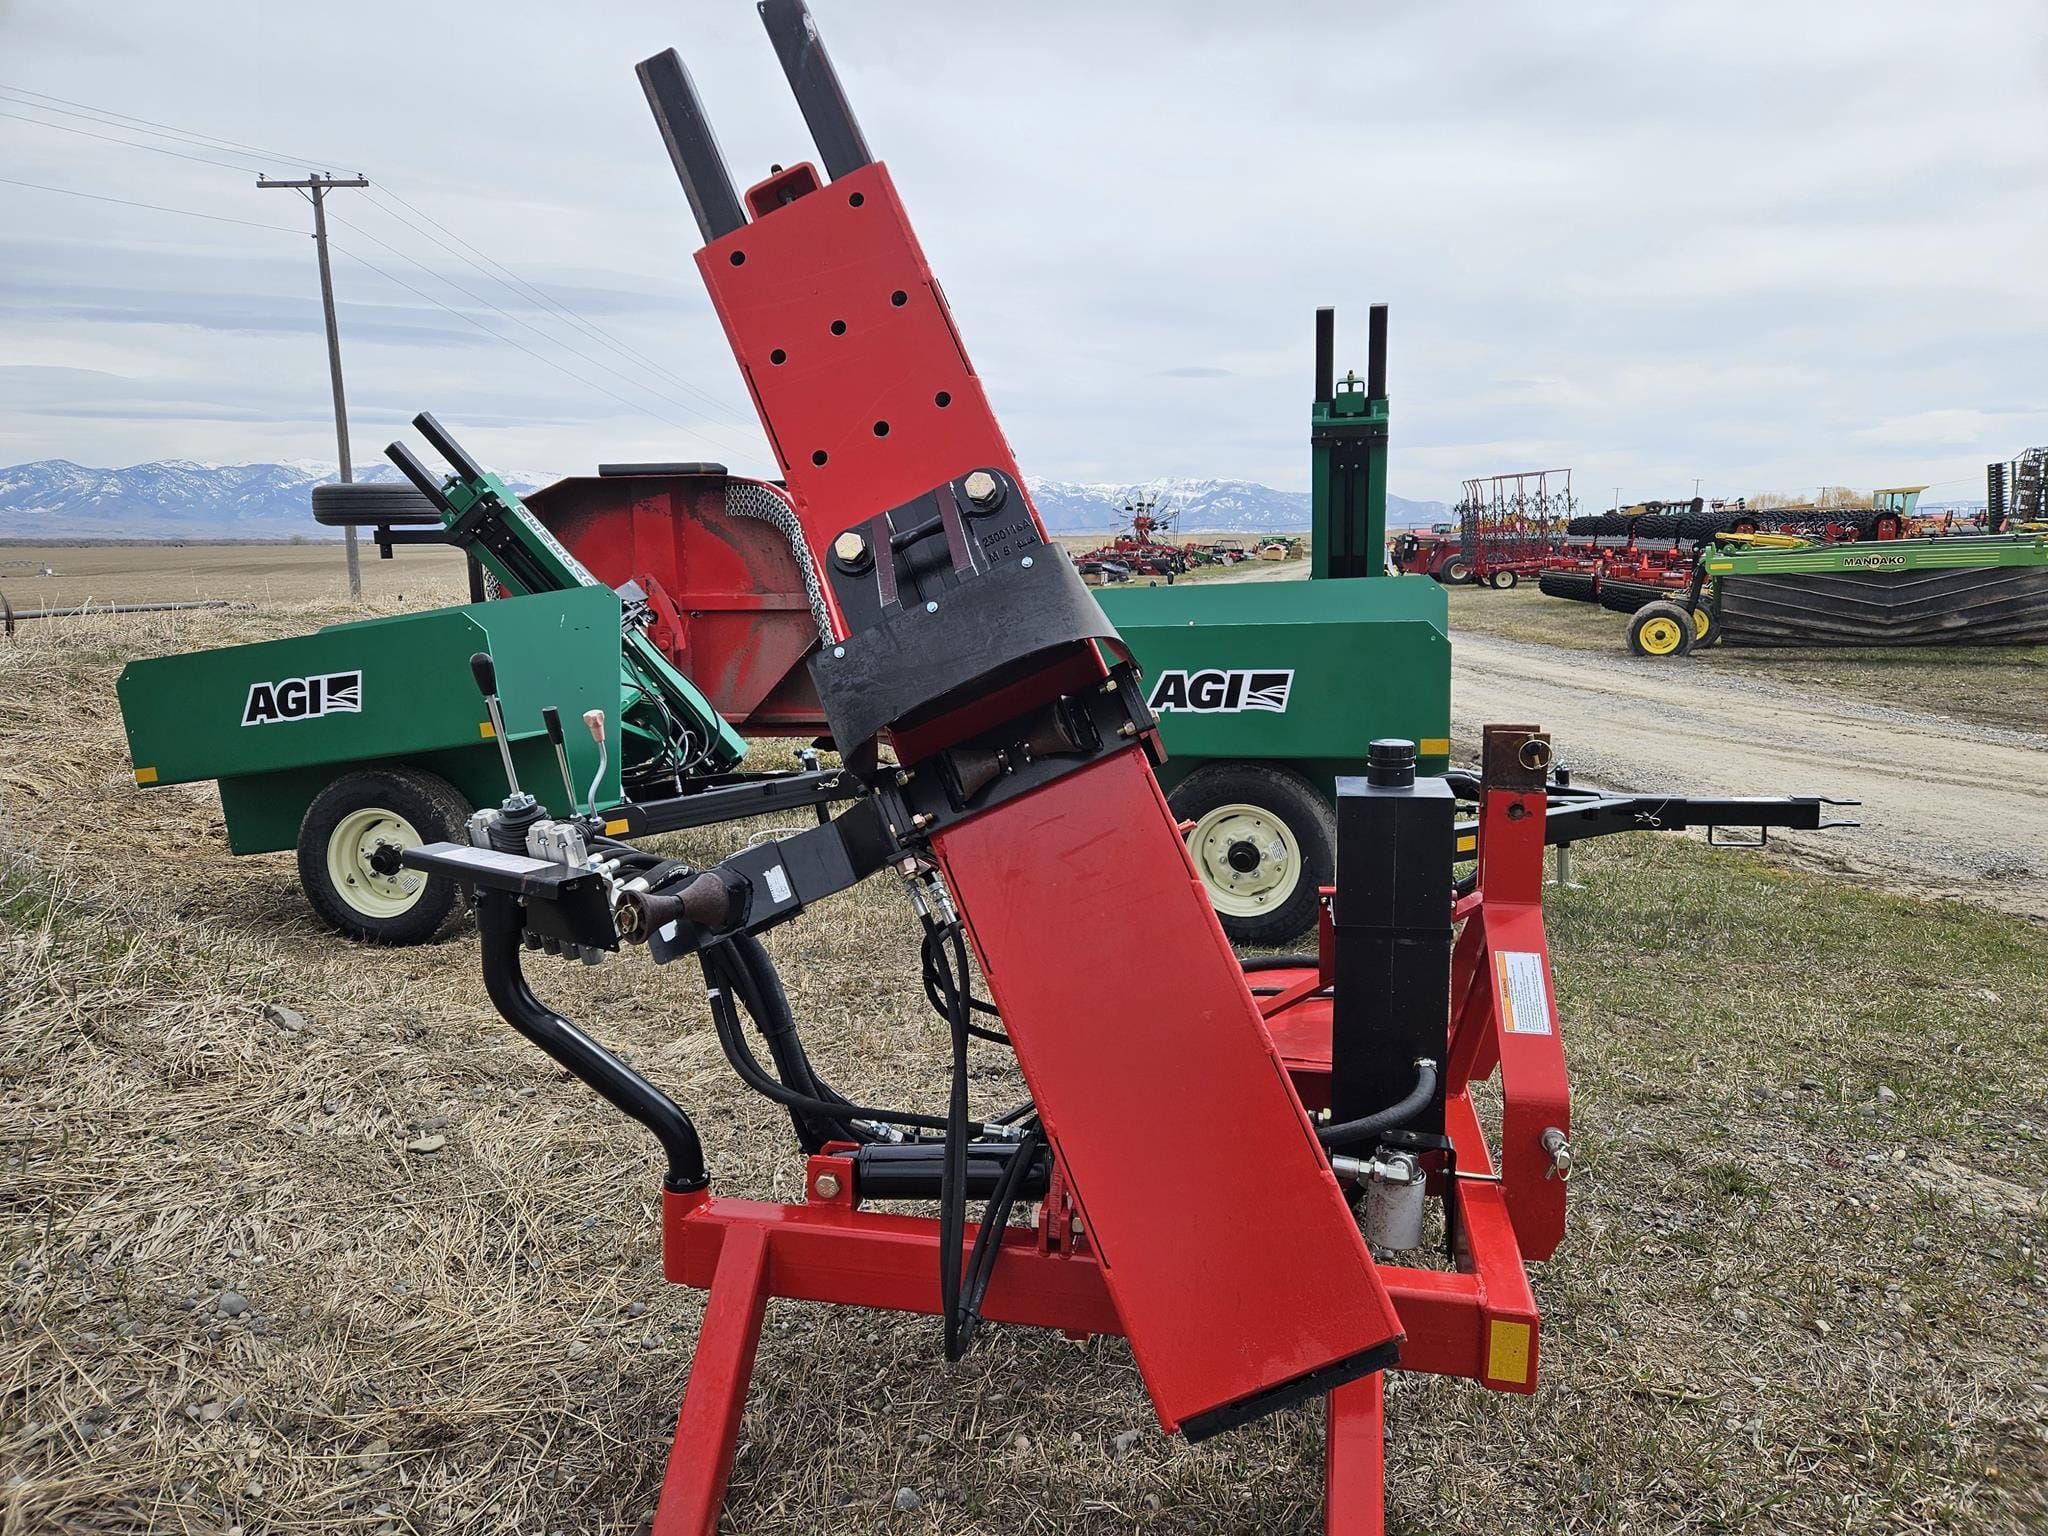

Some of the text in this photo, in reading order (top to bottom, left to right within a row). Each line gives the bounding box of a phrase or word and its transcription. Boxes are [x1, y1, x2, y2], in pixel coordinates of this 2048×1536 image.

[1843, 556, 1906, 567] MANDAKO
[244, 678, 322, 723] AGI
[1149, 672, 1245, 710] AGI
